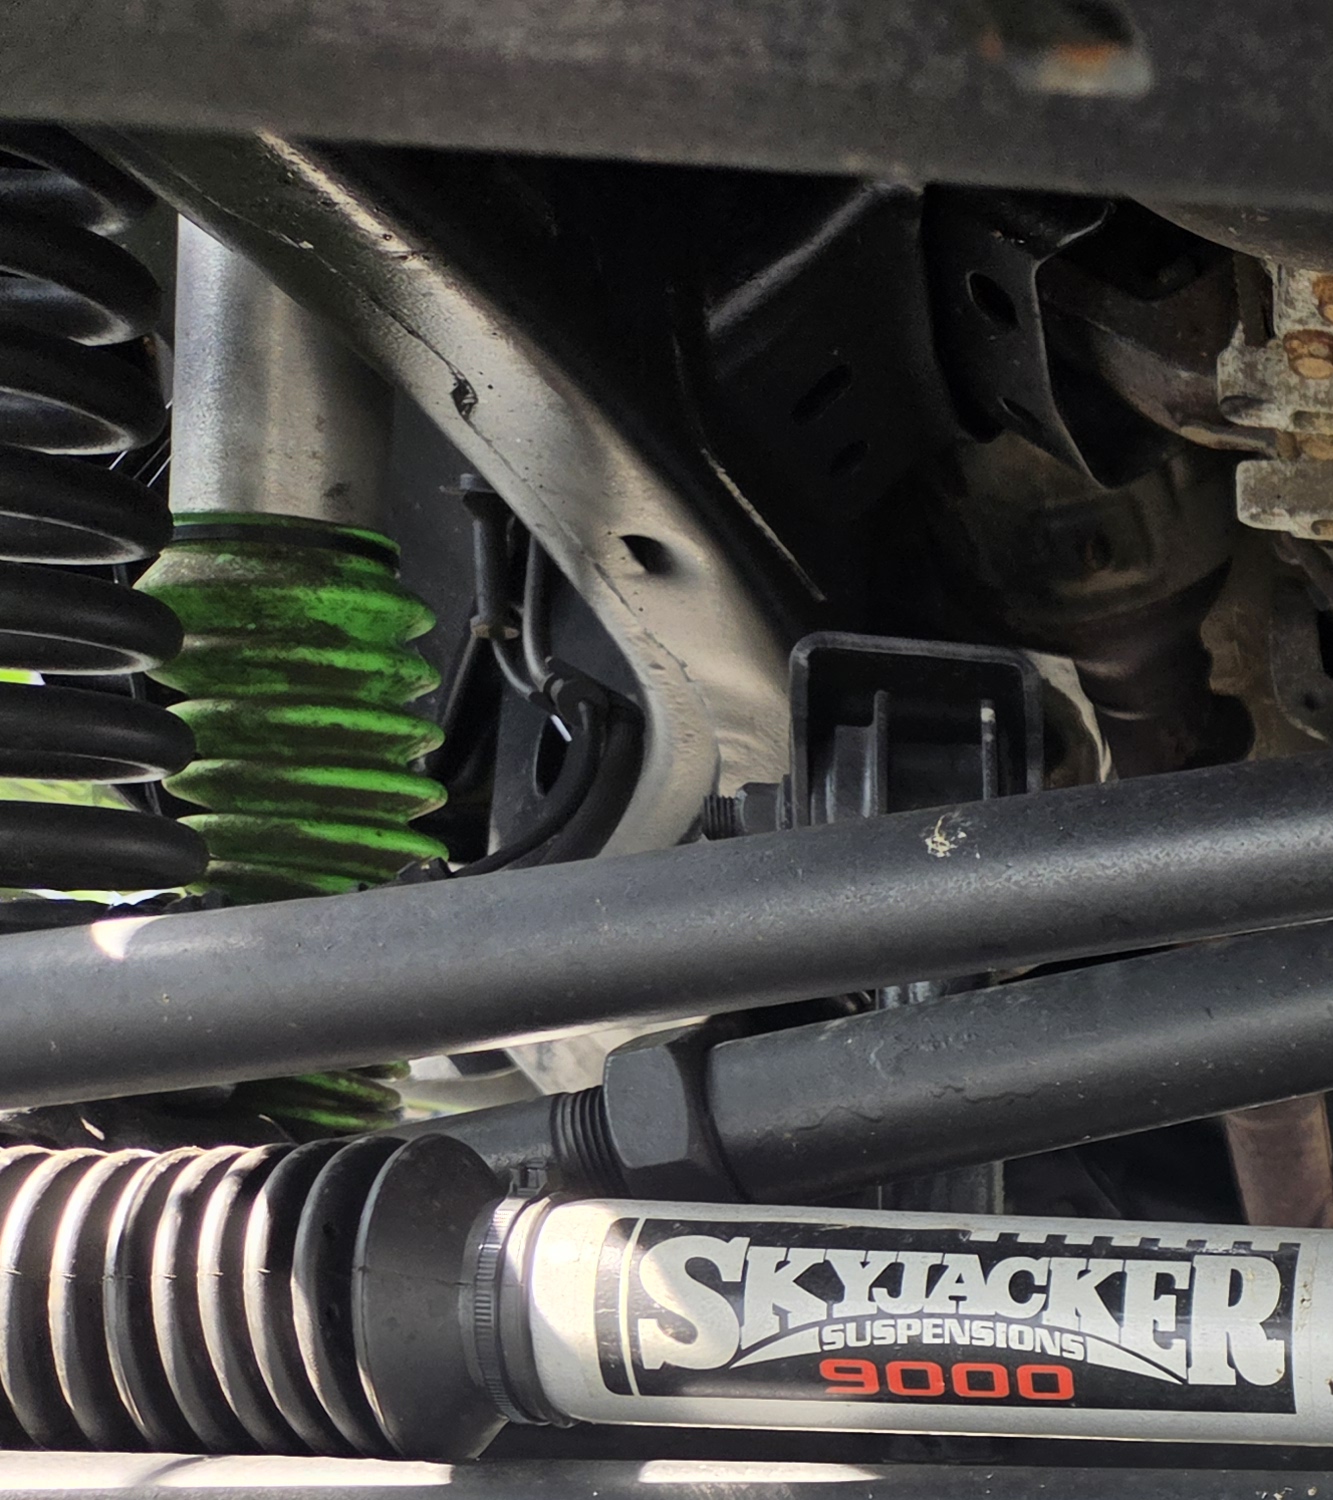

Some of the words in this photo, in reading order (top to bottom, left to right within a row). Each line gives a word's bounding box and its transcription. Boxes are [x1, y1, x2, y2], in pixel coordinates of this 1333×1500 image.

[638, 1235, 1287, 1386] SKYJACKER
[818, 1318, 1088, 1361] SUSPENSIONS
[819, 1358, 1075, 1400] 9000
